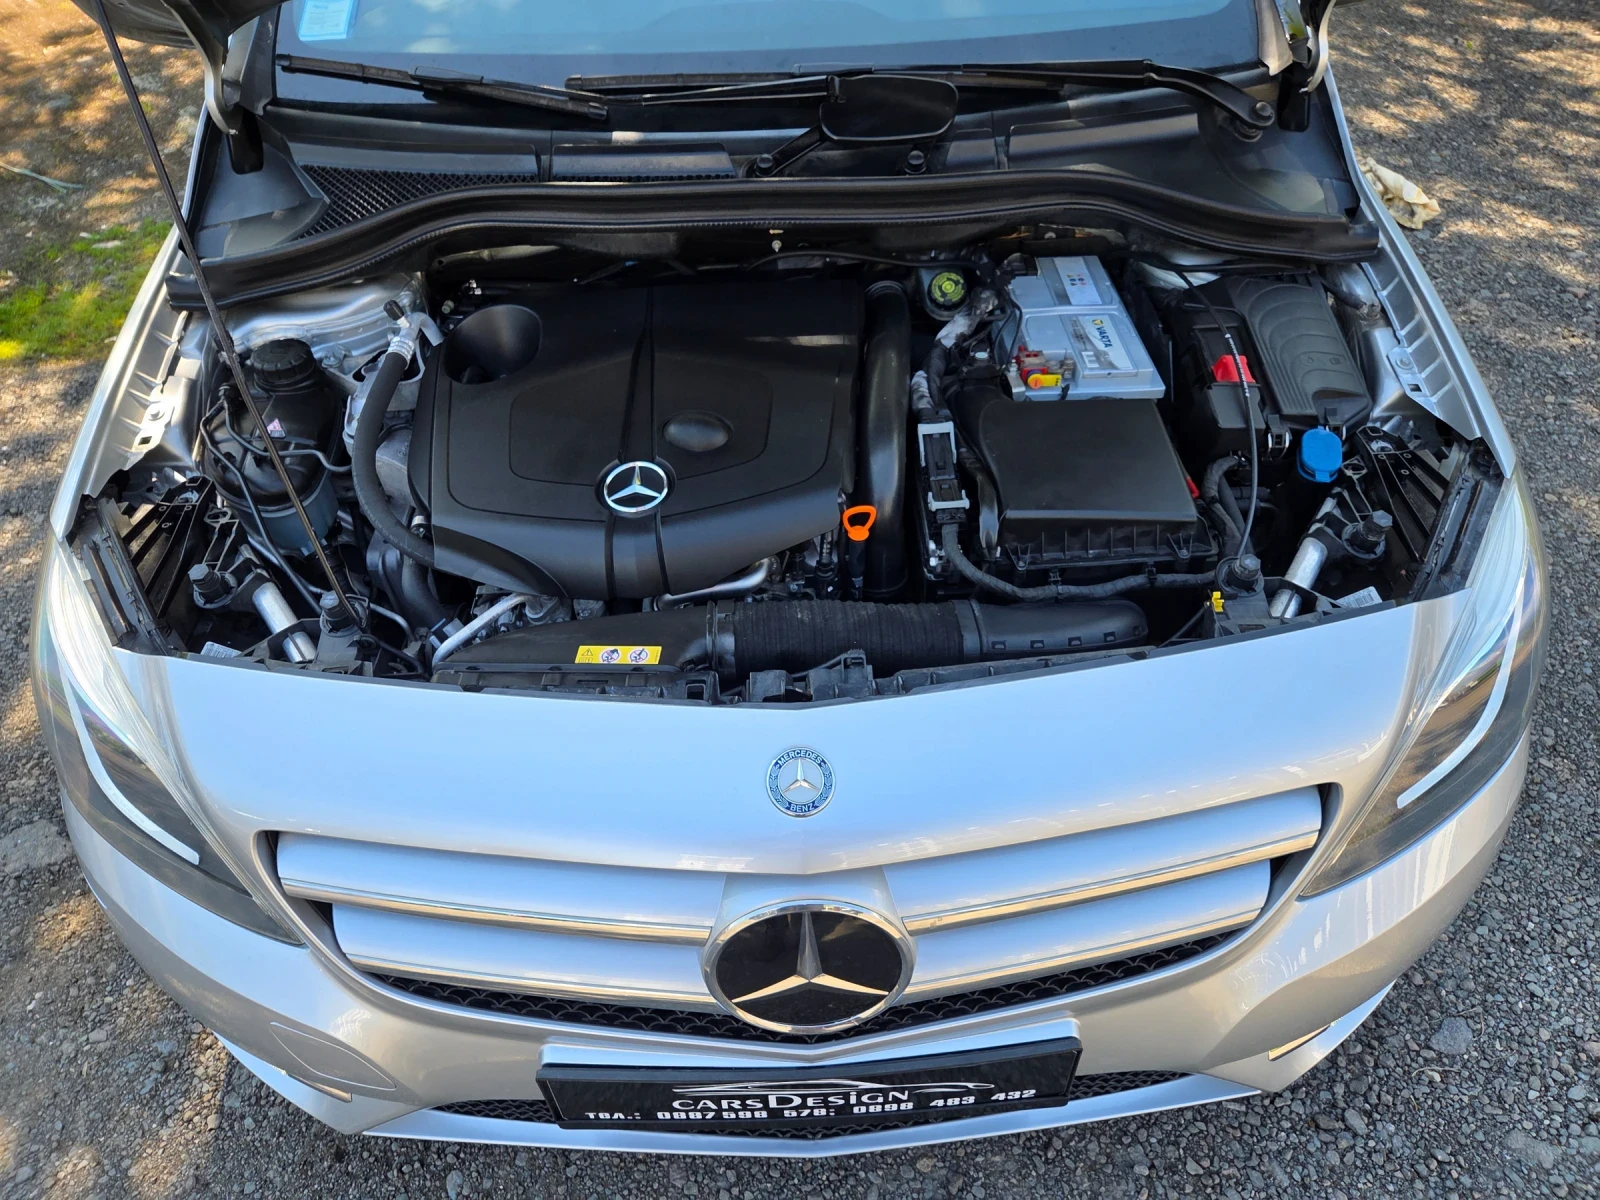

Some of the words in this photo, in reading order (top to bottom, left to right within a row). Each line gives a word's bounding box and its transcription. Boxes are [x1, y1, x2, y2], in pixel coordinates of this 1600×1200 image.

[1096, 326, 1113, 348] VARTA
[777, 749, 823, 766] MERCEDES
[790, 803, 815, 813] BENZ
[657, 1111, 716, 1120] 0887
[722, 1110, 768, 1119] 598
[853, 1102, 914, 1115] 0898
[929, 1096, 976, 1108] 483
[990, 1089, 1037, 1101] 432
